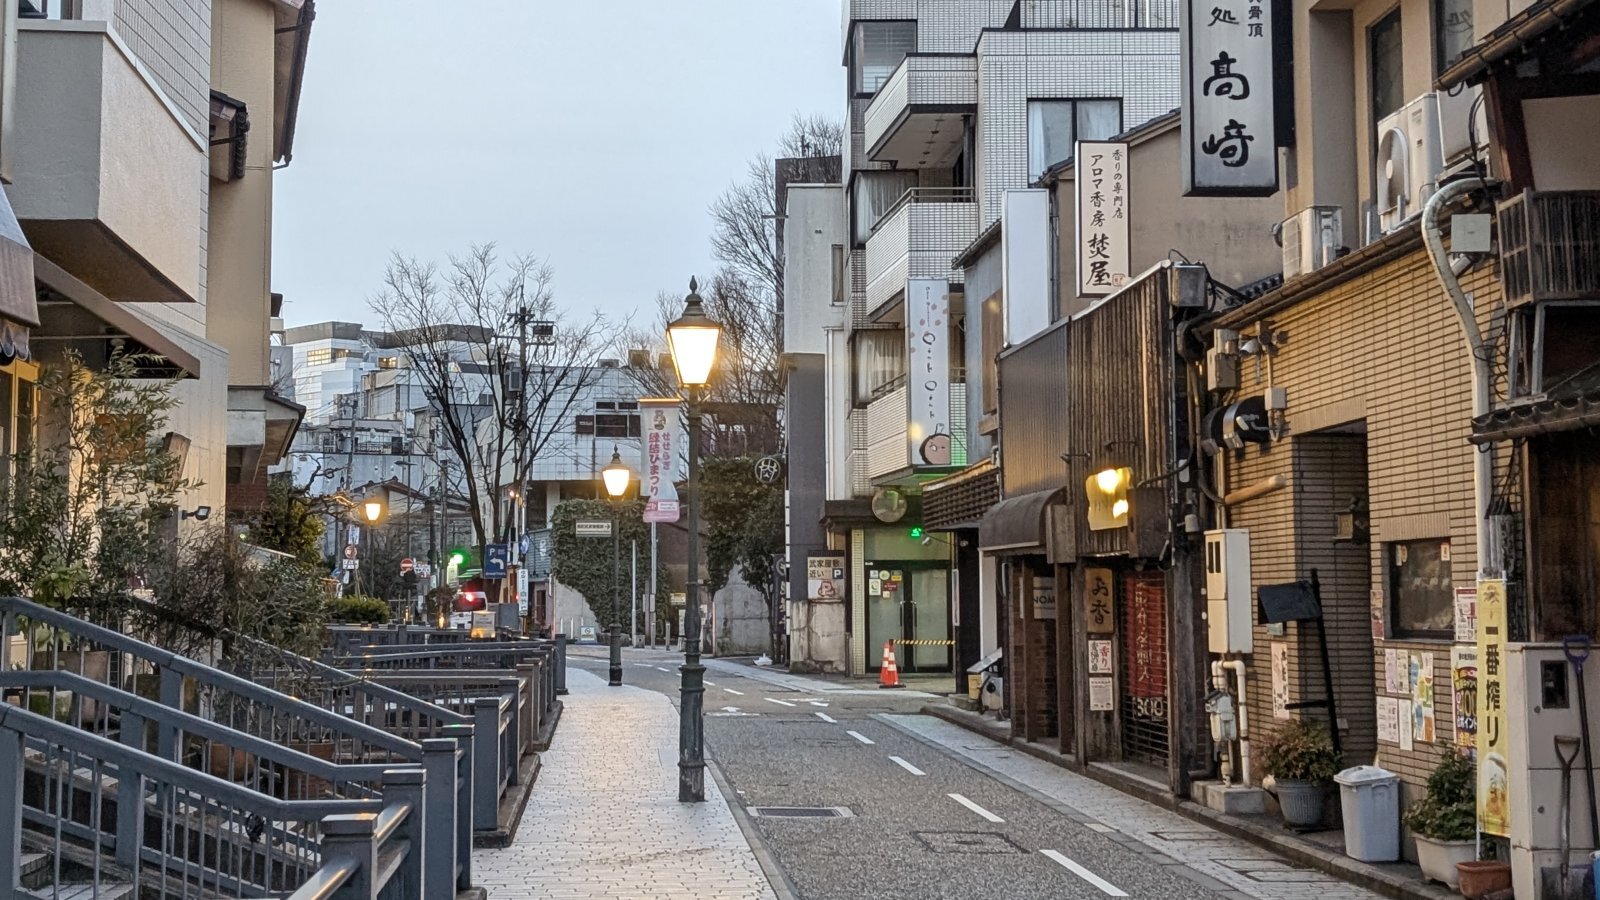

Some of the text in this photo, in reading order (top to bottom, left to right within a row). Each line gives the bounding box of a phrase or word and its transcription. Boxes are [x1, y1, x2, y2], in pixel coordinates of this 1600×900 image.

[1090, 154, 1106, 228] アロマ香房
[1112, 149, 1124, 220] 香りの専門店
[661, 432, 671, 471] せせらぎ
[1090, 578, 1111, 624] お香
[1486, 626, 1500, 748] 一番搾り
